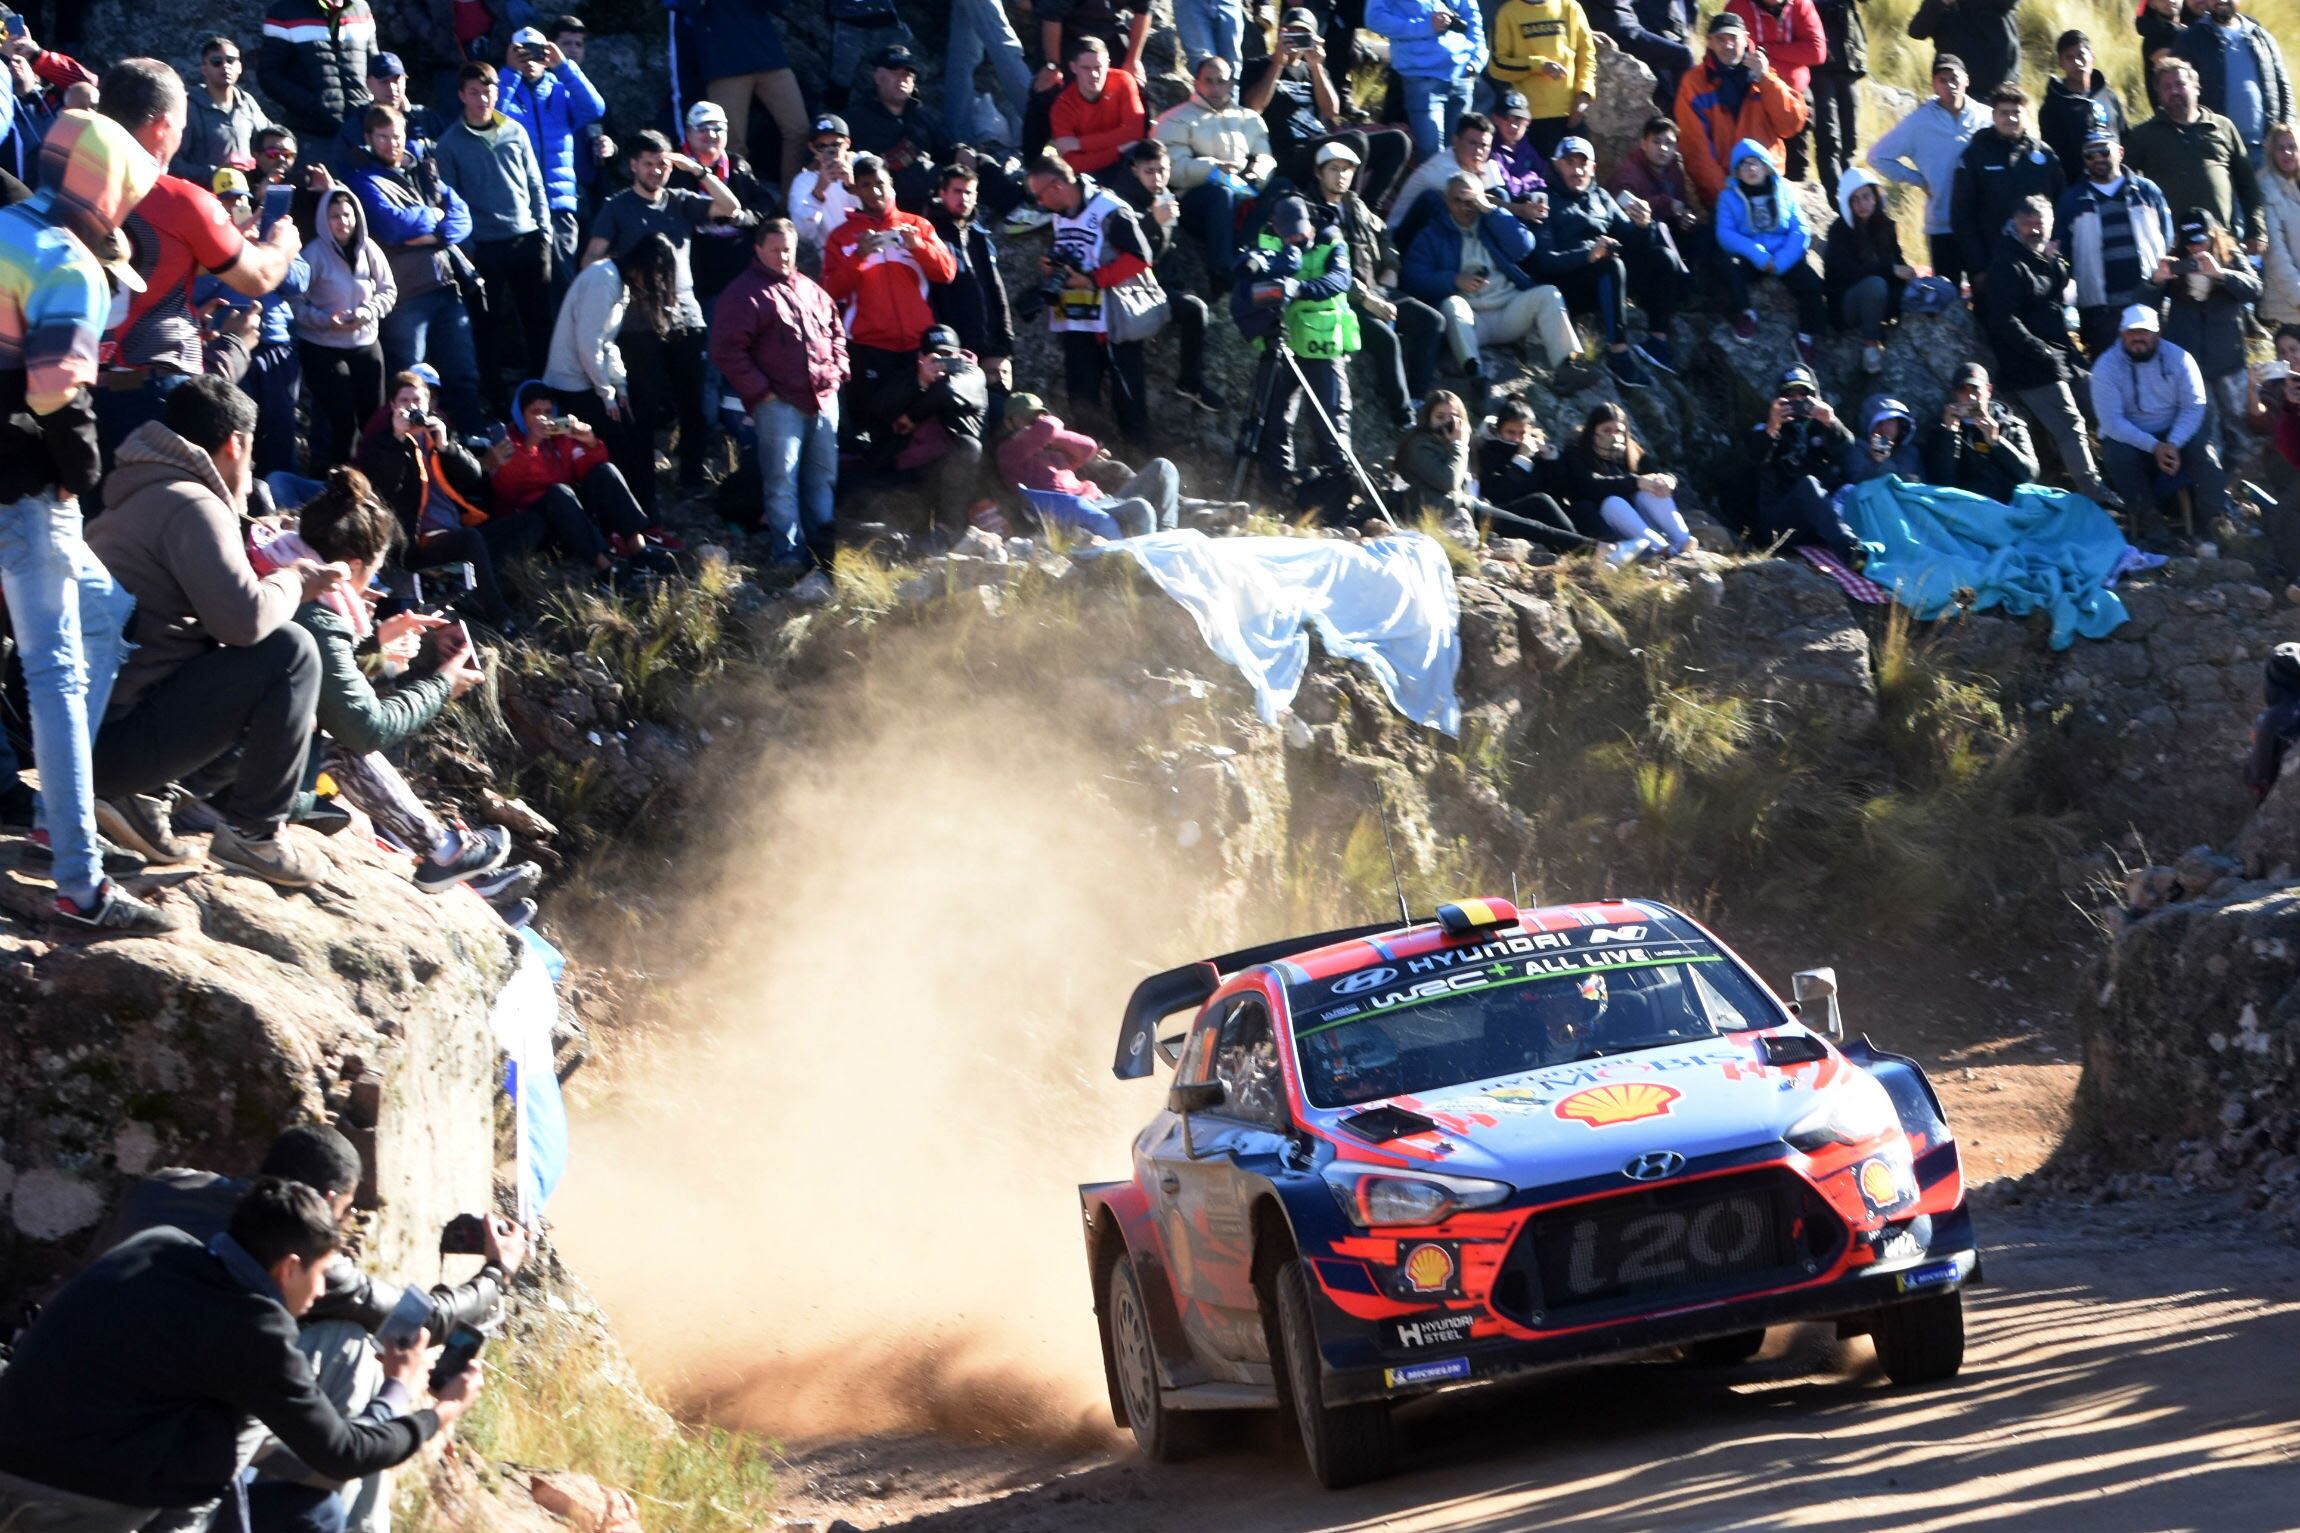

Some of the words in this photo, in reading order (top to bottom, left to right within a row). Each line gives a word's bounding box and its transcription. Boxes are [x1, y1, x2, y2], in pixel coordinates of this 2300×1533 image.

[1407, 932, 1572, 974] HYUNDAI
[1526, 957, 1580, 975] ALL
[1583, 949, 1650, 967] LIVE
[1538, 1051, 1745, 1091] MOBIS
[1420, 1314, 1474, 1333] HYUNDAI
[1423, 1329, 1462, 1344] STEEL
